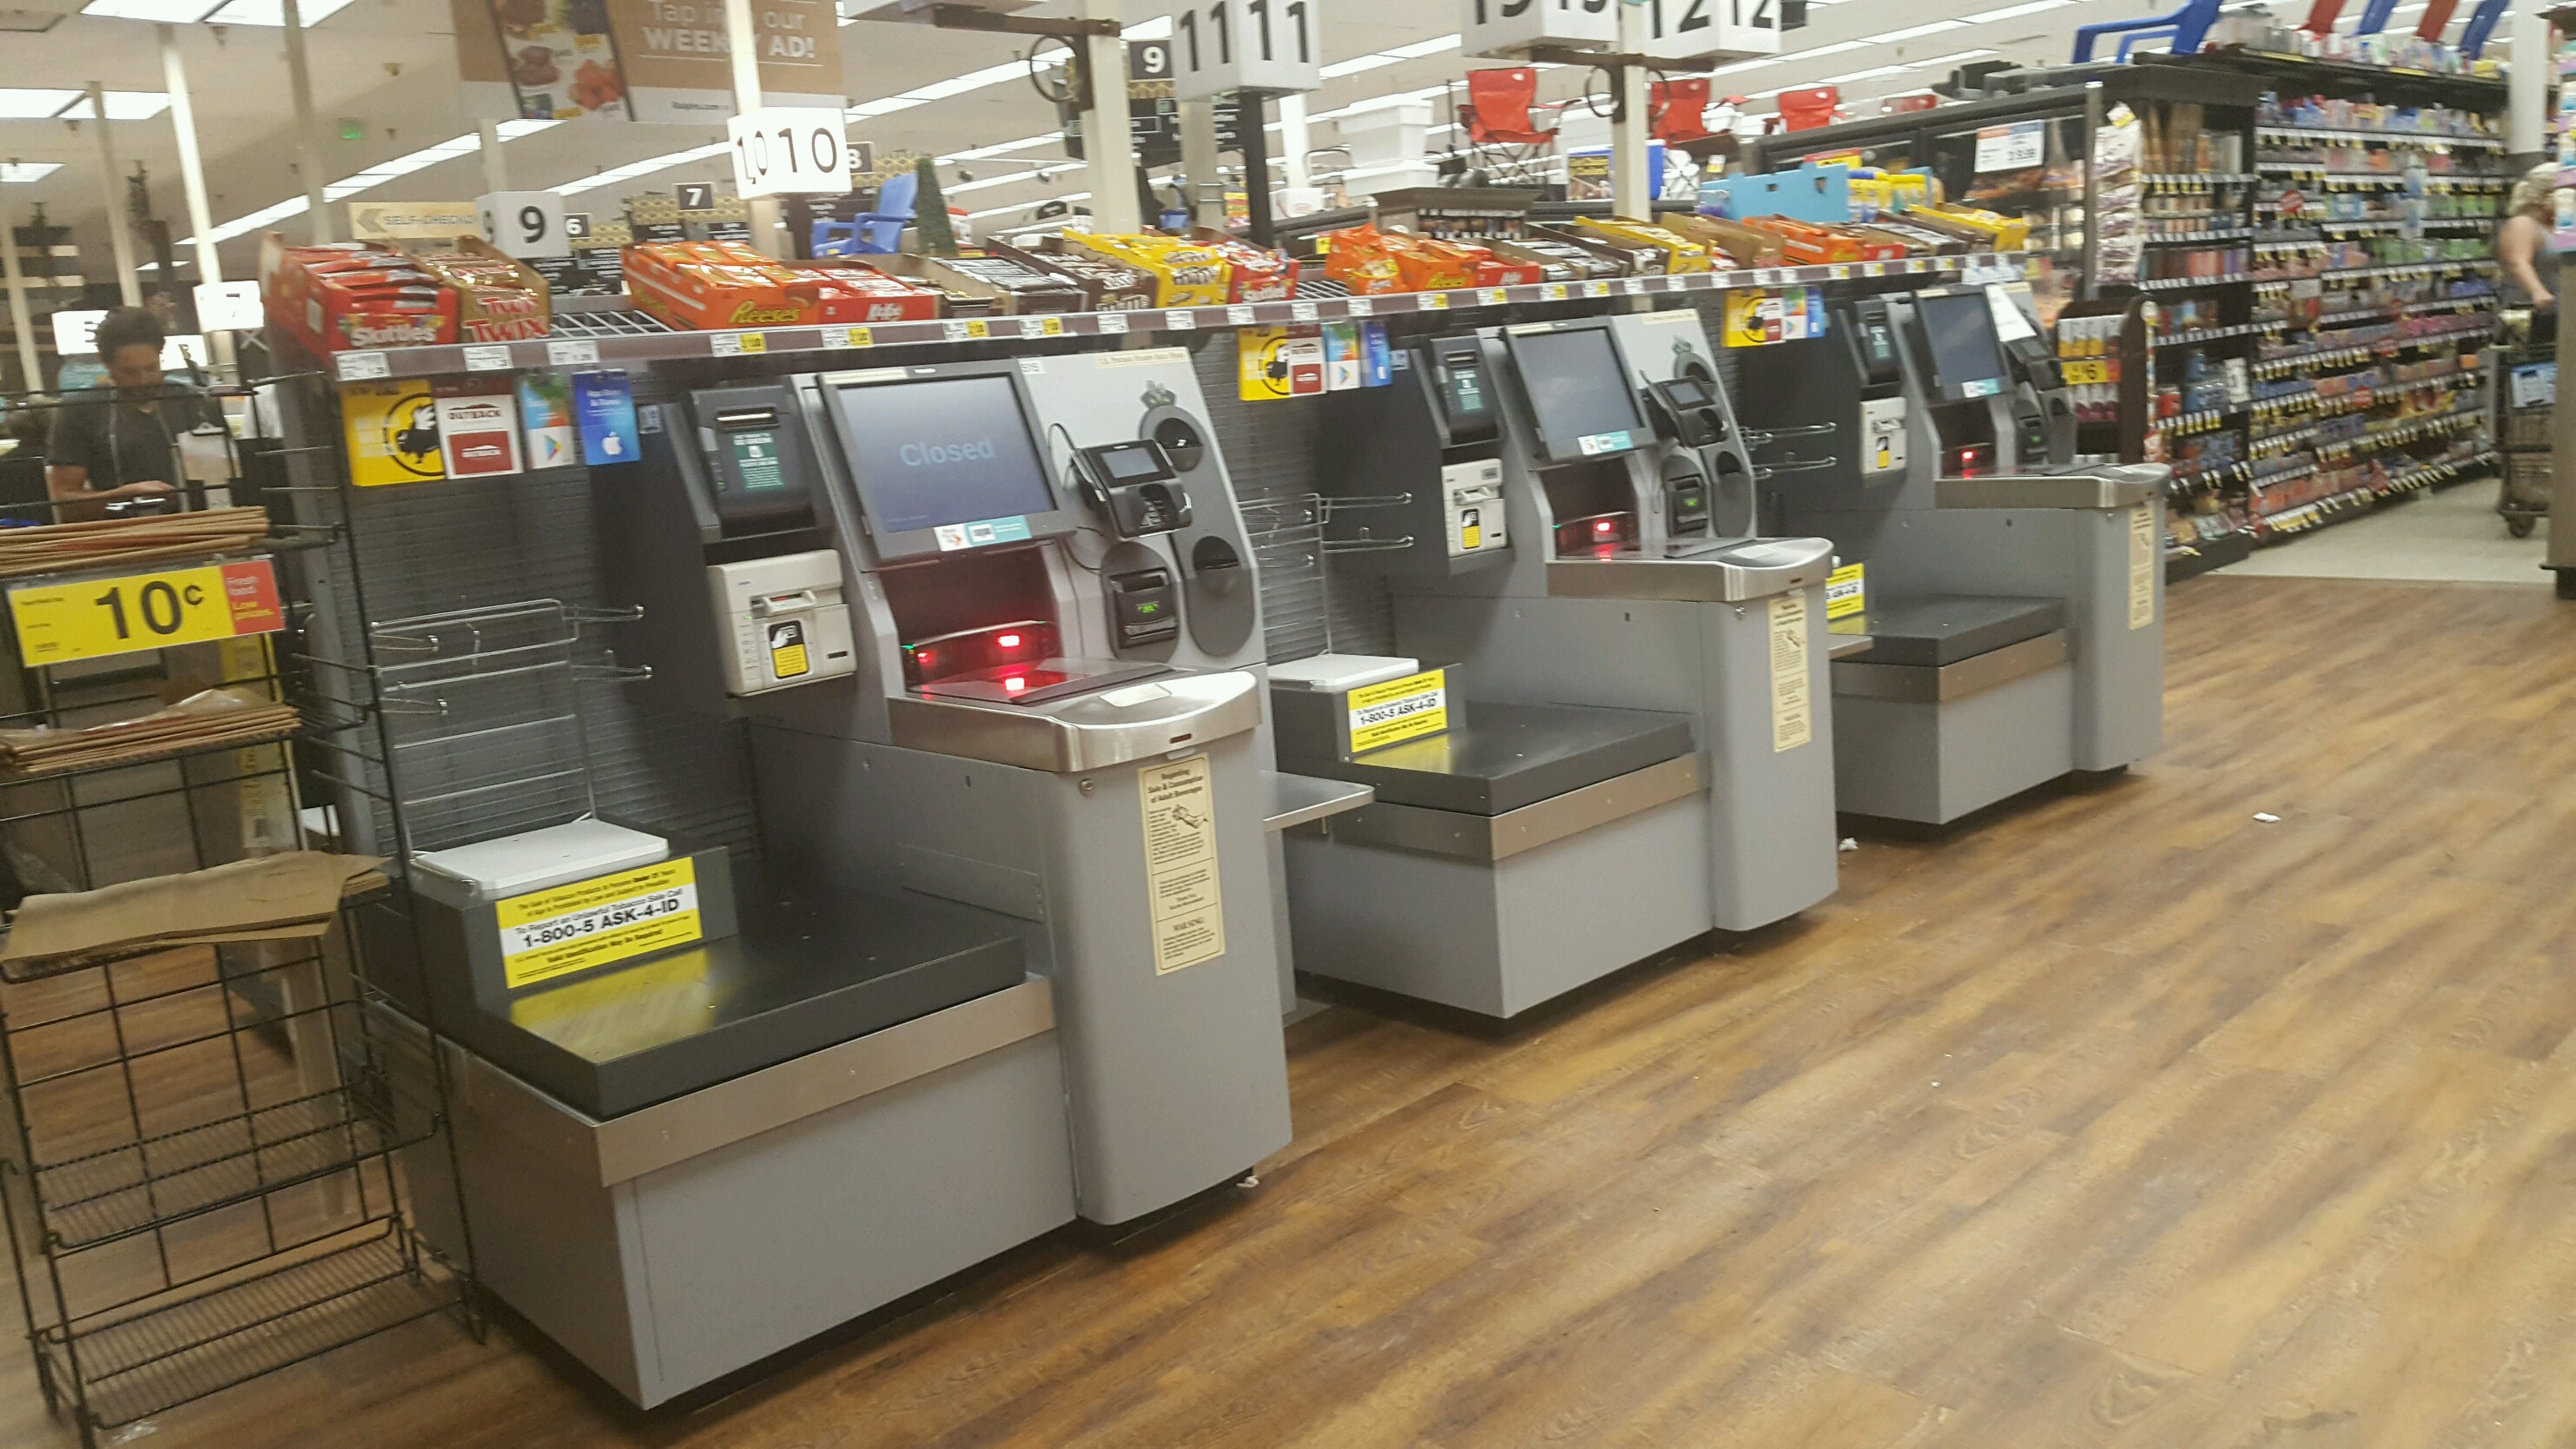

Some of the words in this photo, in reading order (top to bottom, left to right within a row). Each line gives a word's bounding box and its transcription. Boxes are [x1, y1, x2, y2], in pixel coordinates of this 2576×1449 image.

[763, 11, 805, 30] our
[1249, 0, 1309, 63] 11
[643, 26, 761, 54] WEEK
[769, 35, 816, 58] AD!
[1179, 10, 1231, 71] 11
[1142, 46, 1166, 74] 9
[778, 128, 837, 173] 10
[686, 188, 703, 206] 7
[519, 205, 545, 243] 9
[565, 218, 583, 235] 6
[899, 436, 994, 466] Closed
[523, 919, 594, 948] 1-800-5
[601, 898, 680, 929] ASK-4-ID
[528, 919, 558, 932] Report
[611, 898, 646, 910] Tobacco
[648, 893, 664, 903] Sale
[667, 888, 683, 898] Call
